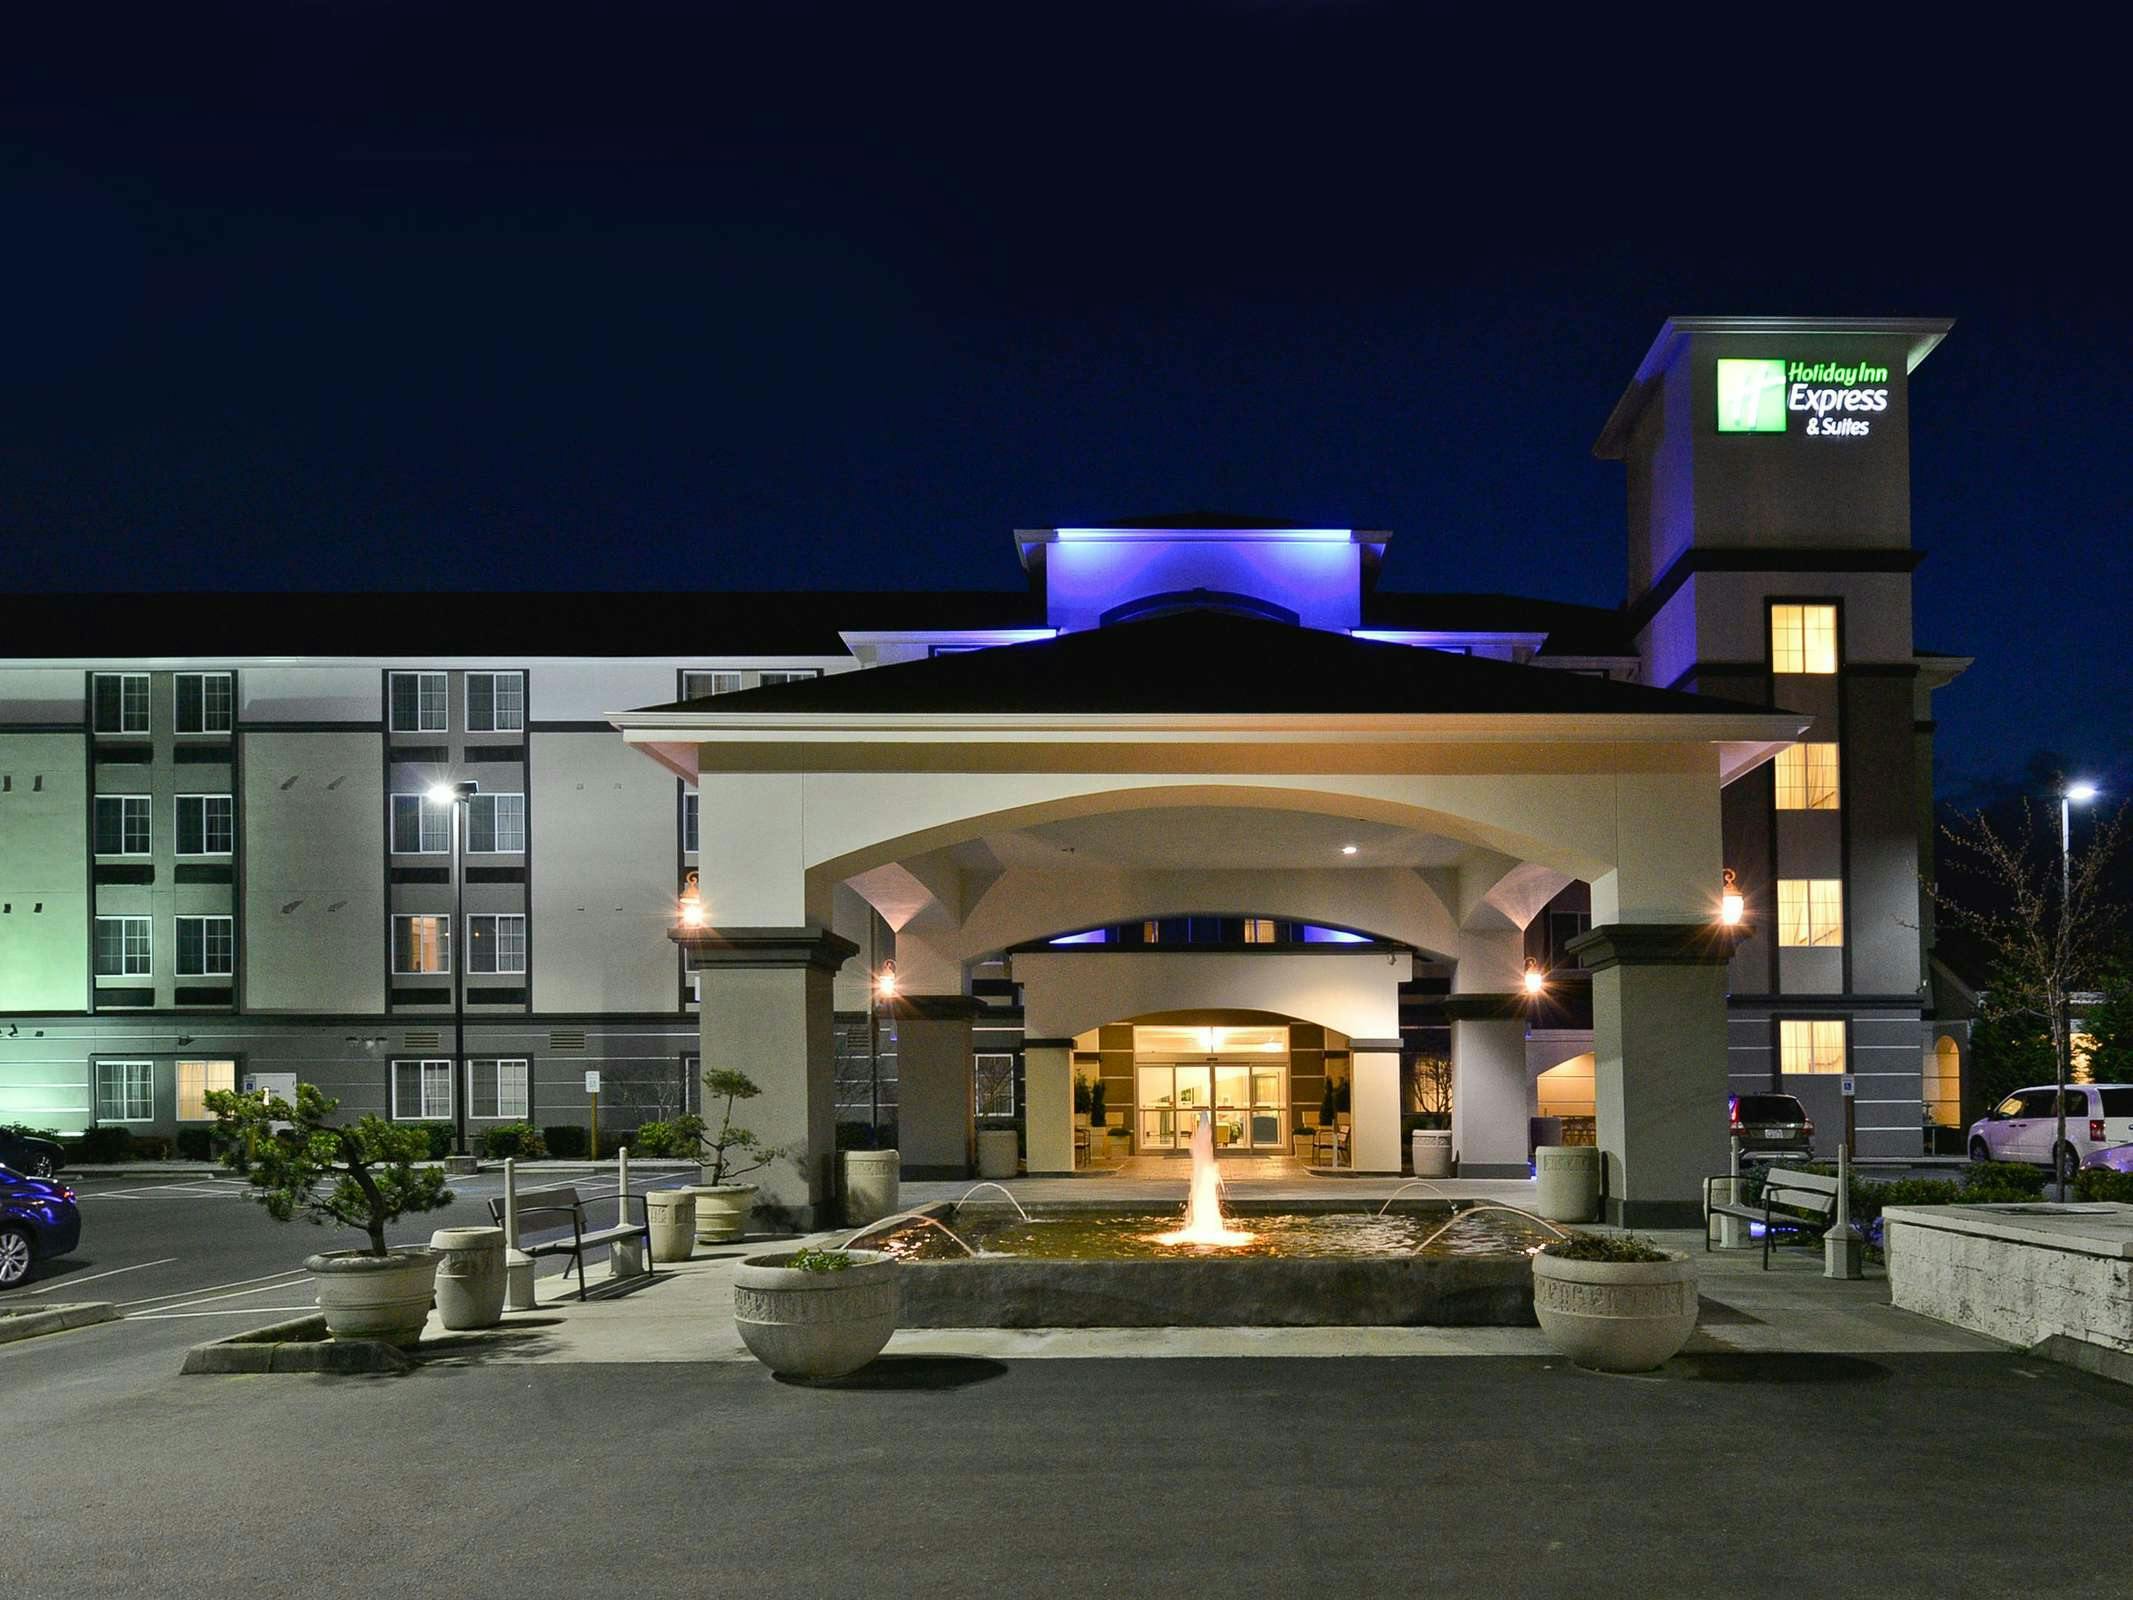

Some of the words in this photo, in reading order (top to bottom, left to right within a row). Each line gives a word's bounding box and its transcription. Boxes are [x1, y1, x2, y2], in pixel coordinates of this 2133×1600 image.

[1788, 362, 1857, 386] Holiday
[1859, 362, 1888, 382] Inn
[1789, 383, 1888, 417] Express
[1806, 417, 1819, 435] &
[1821, 417, 1869, 436] Suites
